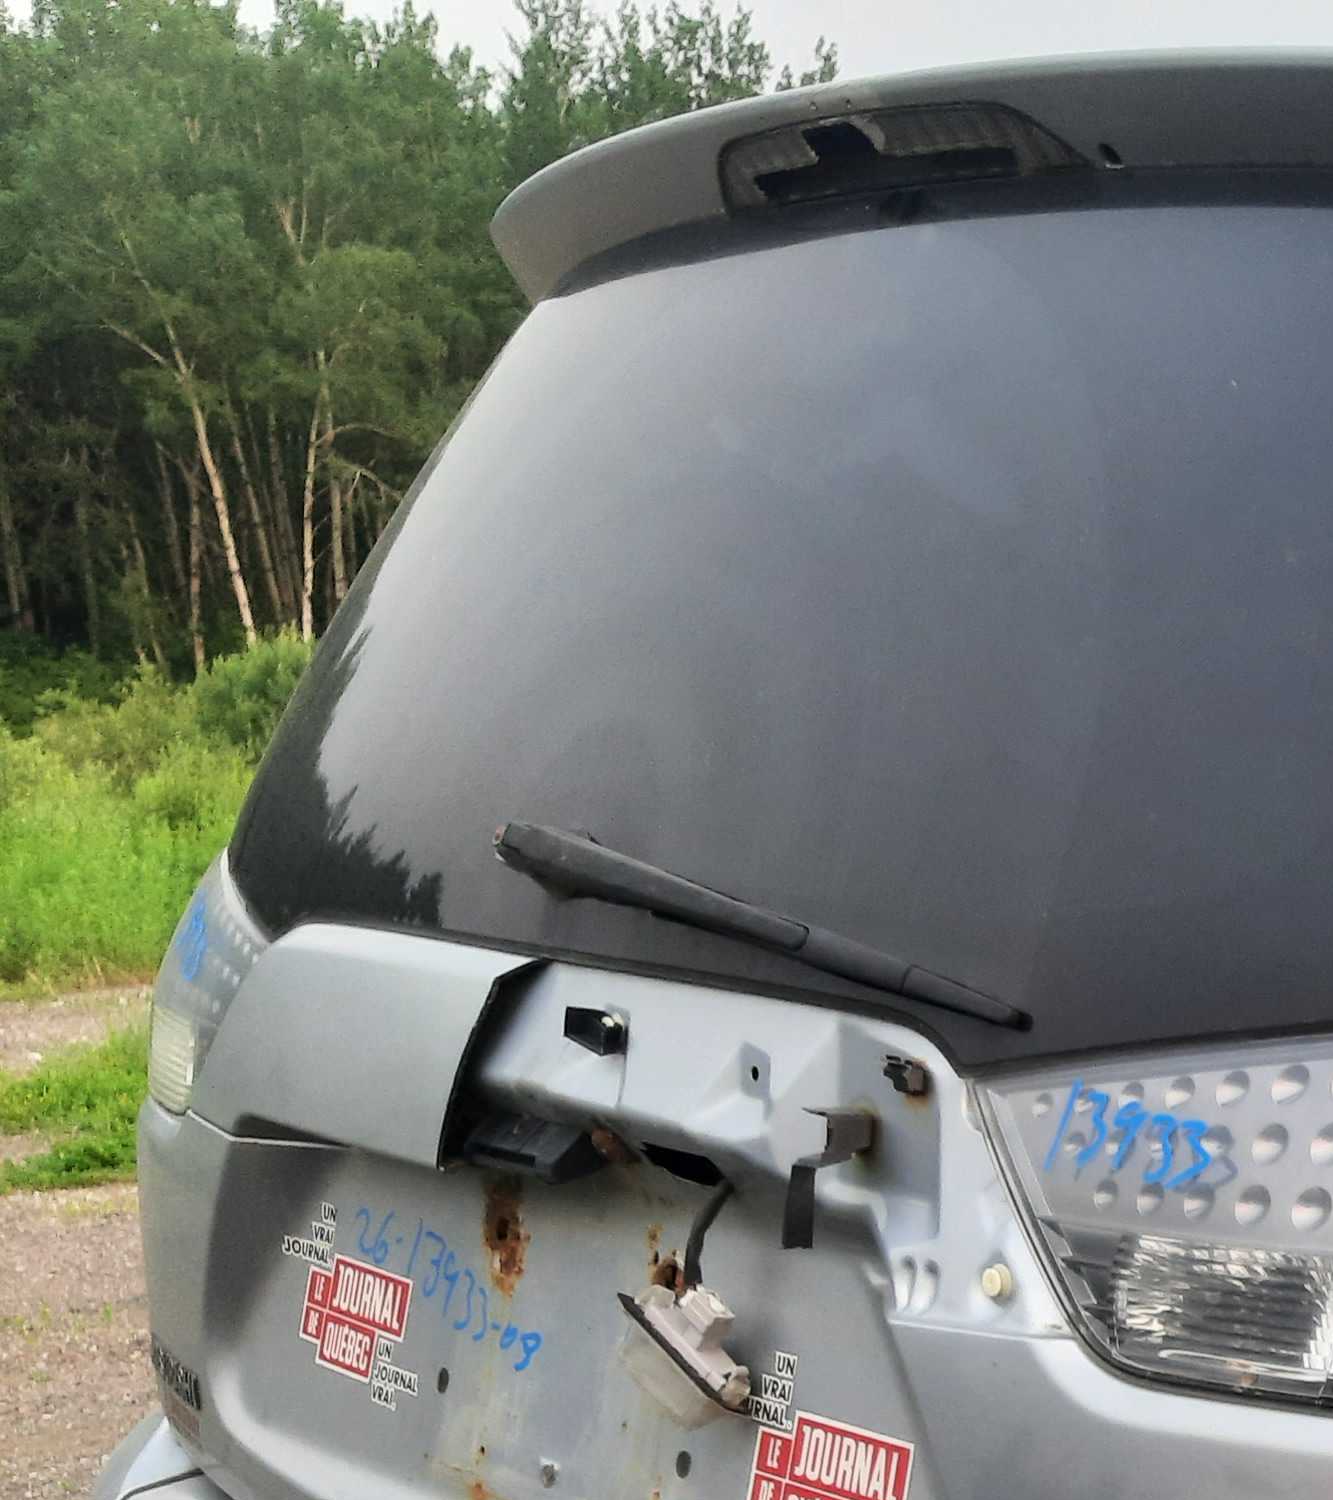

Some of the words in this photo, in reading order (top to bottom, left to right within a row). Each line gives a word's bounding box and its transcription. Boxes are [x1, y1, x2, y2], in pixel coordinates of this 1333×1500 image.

[1043, 1078, 1214, 1191] 13933
[322, 1204, 336, 1222] UN
[313, 1225, 334, 1243] VRAI
[314, 1275, 326, 1300] LE
[332, 1263, 403, 1330] JOURNAL
[306, 1310, 319, 1334] DE
[322, 1320, 371, 1372] QUÉBEC
[378, 1341, 392, 1359] UN
[777, 1353, 796, 1375] UN
[373, 1365, 418, 1394] JOURNAL
[763, 1377, 792, 1401] VRAI
[751, 1400, 793, 1429] RNAL.
[767, 1438, 782, 1469] LE
